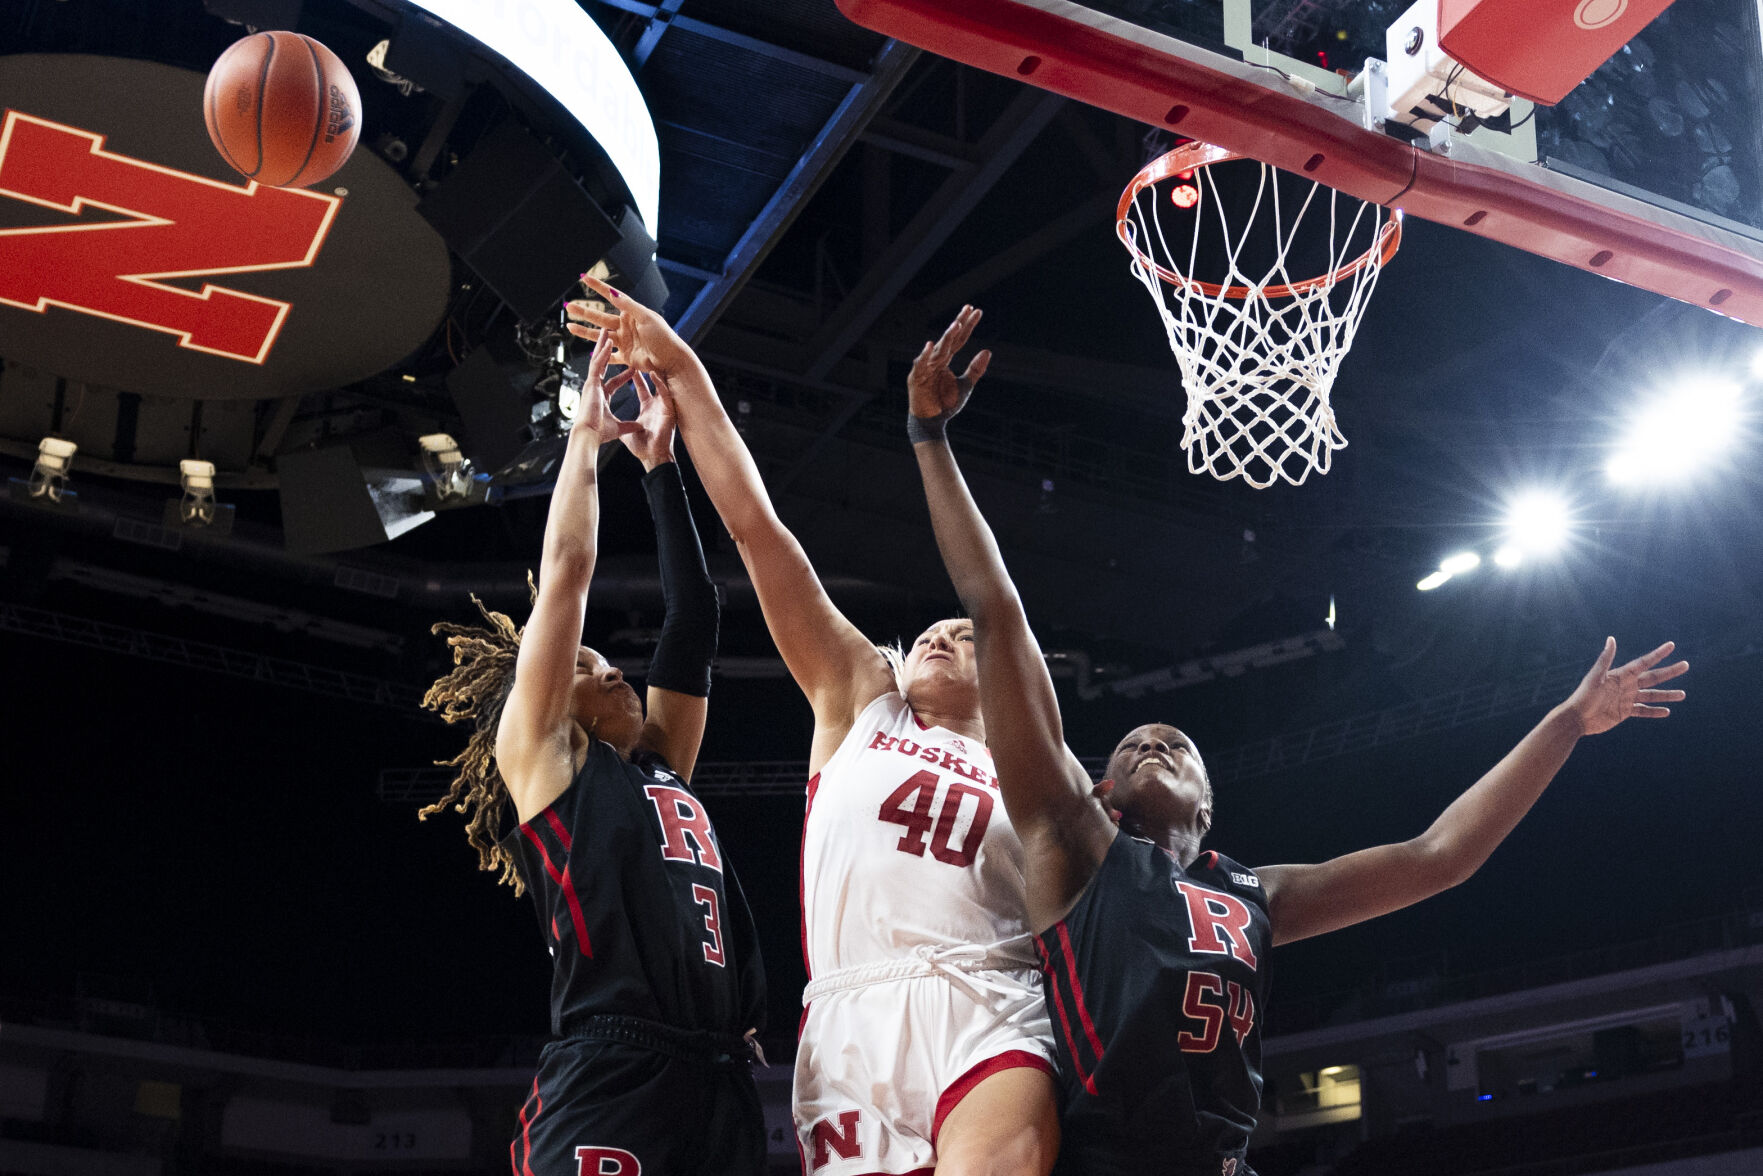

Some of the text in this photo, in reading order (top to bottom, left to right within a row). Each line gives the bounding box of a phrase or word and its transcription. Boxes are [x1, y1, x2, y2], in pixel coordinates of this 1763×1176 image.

[643, 784, 723, 873] R
[878, 769, 994, 868] 40
[692, 883, 725, 968] 3
[1175, 880, 1257, 972] R
[1178, 970, 1255, 1053] 54
[1684, 1026, 1728, 1048] 216
[375, 1133, 416, 1150] 213
[812, 1109, 864, 1174] N
